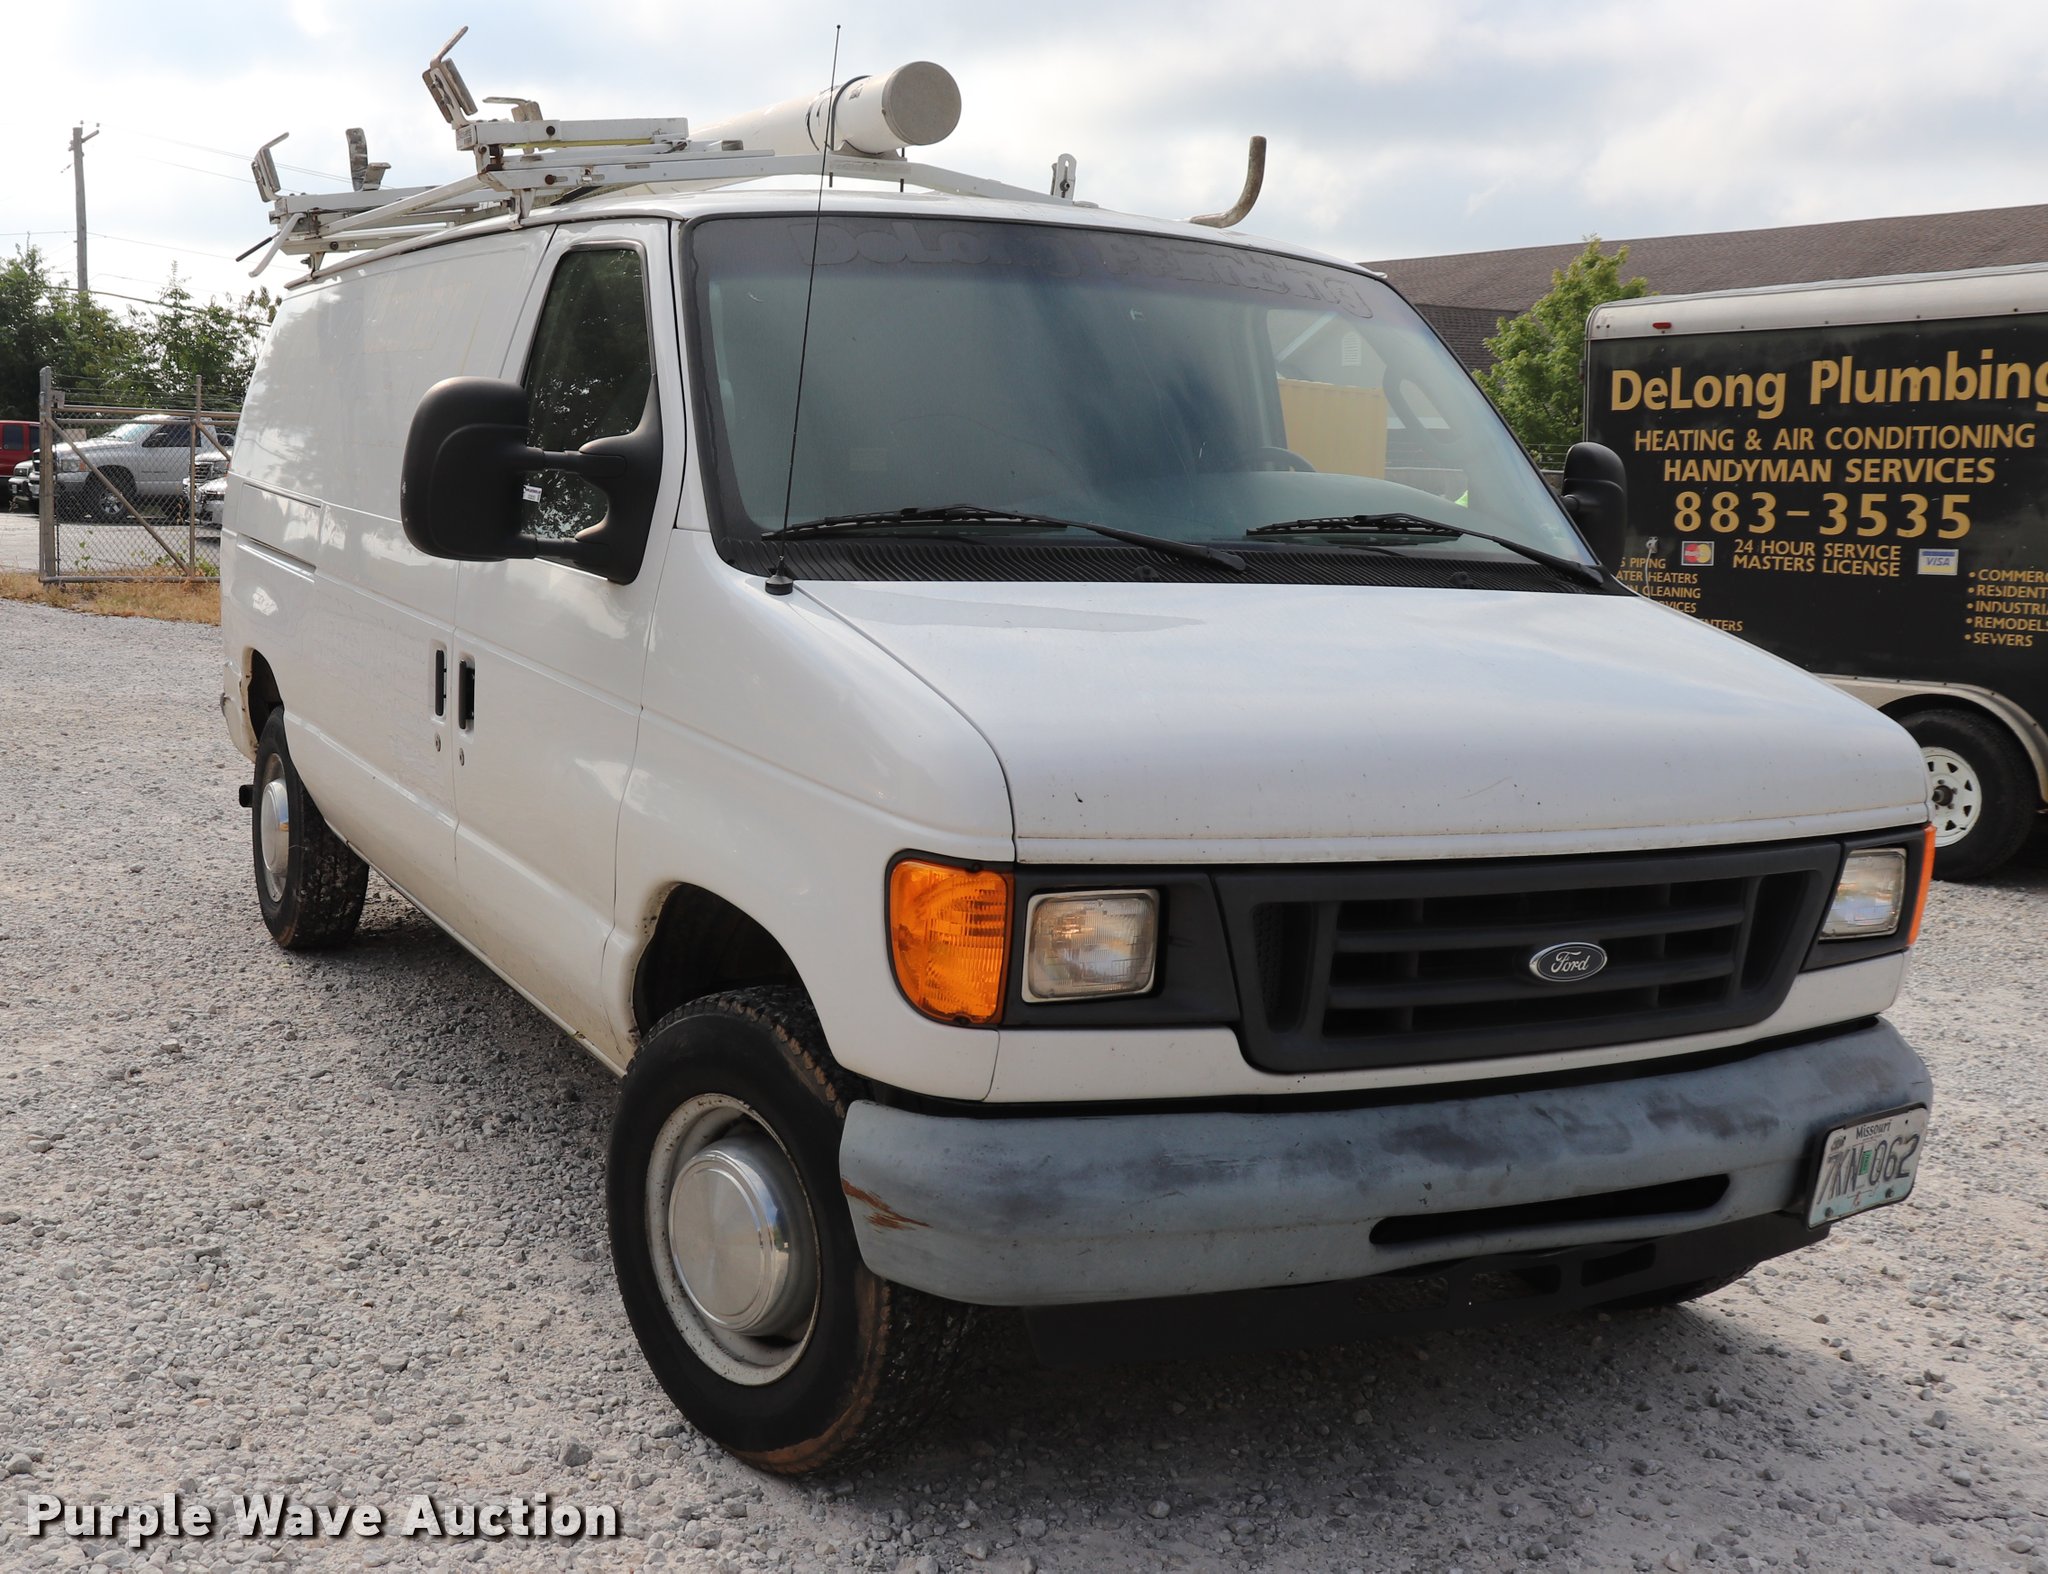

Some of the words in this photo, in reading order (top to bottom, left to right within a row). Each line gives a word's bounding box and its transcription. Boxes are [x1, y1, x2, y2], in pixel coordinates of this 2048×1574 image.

[1611, 367, 1786, 420] DeLong
[1634, 428, 1734, 452] HEATING
[1744, 428, 1763, 451] &
[1773, 427, 1815, 451] AIR
[1825, 423, 2036, 450] CONDITIONING
[1663, 458, 1832, 482] HANDYMAN
[1844, 457, 1996, 484] SERVICES
[1673, 490, 1972, 540] 883-3535
[1733, 538, 1754, 553] 24
[1760, 540, 1816, 556] HOUR
[1824, 542, 1901, 561] SERVICE
[1629, 557, 1667, 569] PIPING
[1732, 555, 1816, 573] MASTERS
[1821, 558, 1900, 577] LICENSE
[1925, 557, 1950, 566] VISA
[1615, 570, 1643, 582] ATER
[1648, 572, 1698, 584] HEATERS
[1642, 586, 1702, 599] CLEANING
[1974, 600, 2048, 616] INDUSTRI
[1973, 616, 2048, 632] REMODEL
[1972, 632, 2033, 647] SEWERS
[1551, 951, 1591, 973] Ford
[1868, 1133, 1921, 1187] 062
